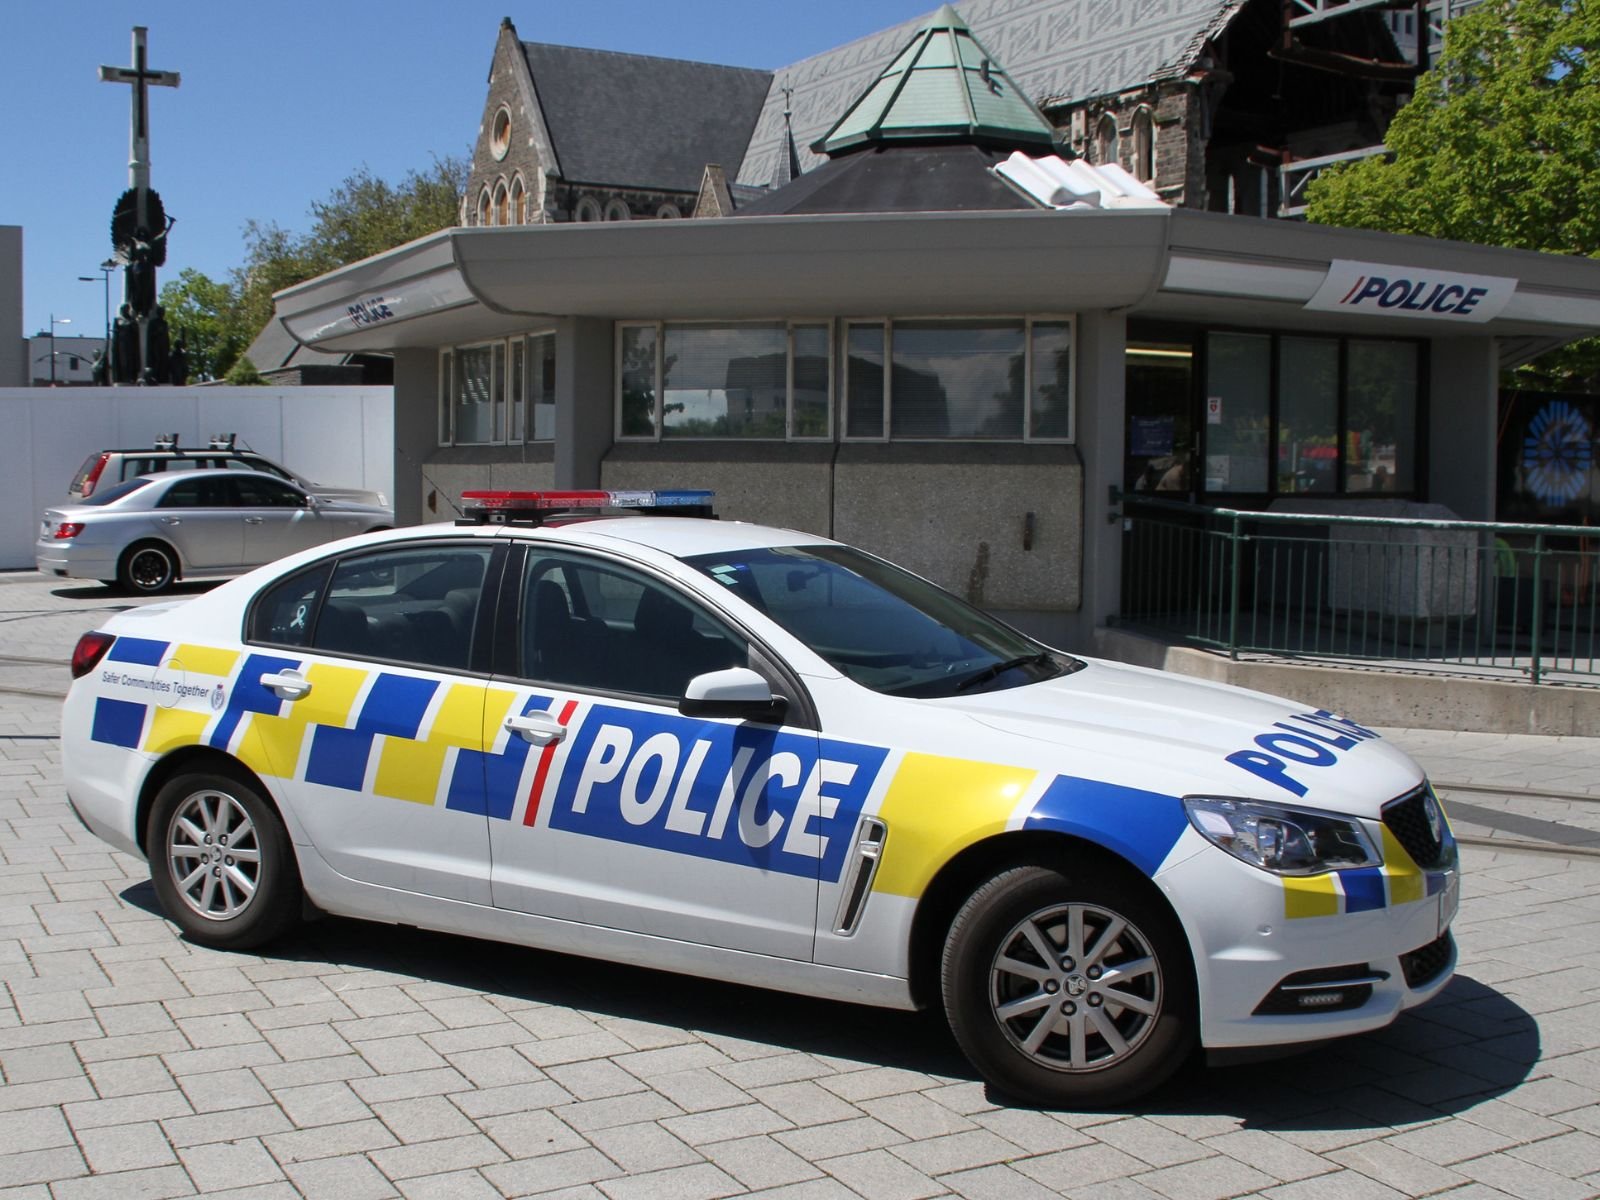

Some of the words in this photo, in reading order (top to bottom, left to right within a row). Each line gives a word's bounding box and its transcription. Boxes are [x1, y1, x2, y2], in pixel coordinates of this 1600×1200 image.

[347, 296, 394, 328] POLICE
[1349, 276, 1488, 315] POLICE
[102, 671, 121, 684] Safer
[121, 674, 171, 693] Communities
[173, 681, 209, 698] Together
[571, 723, 859, 859] POLICE
